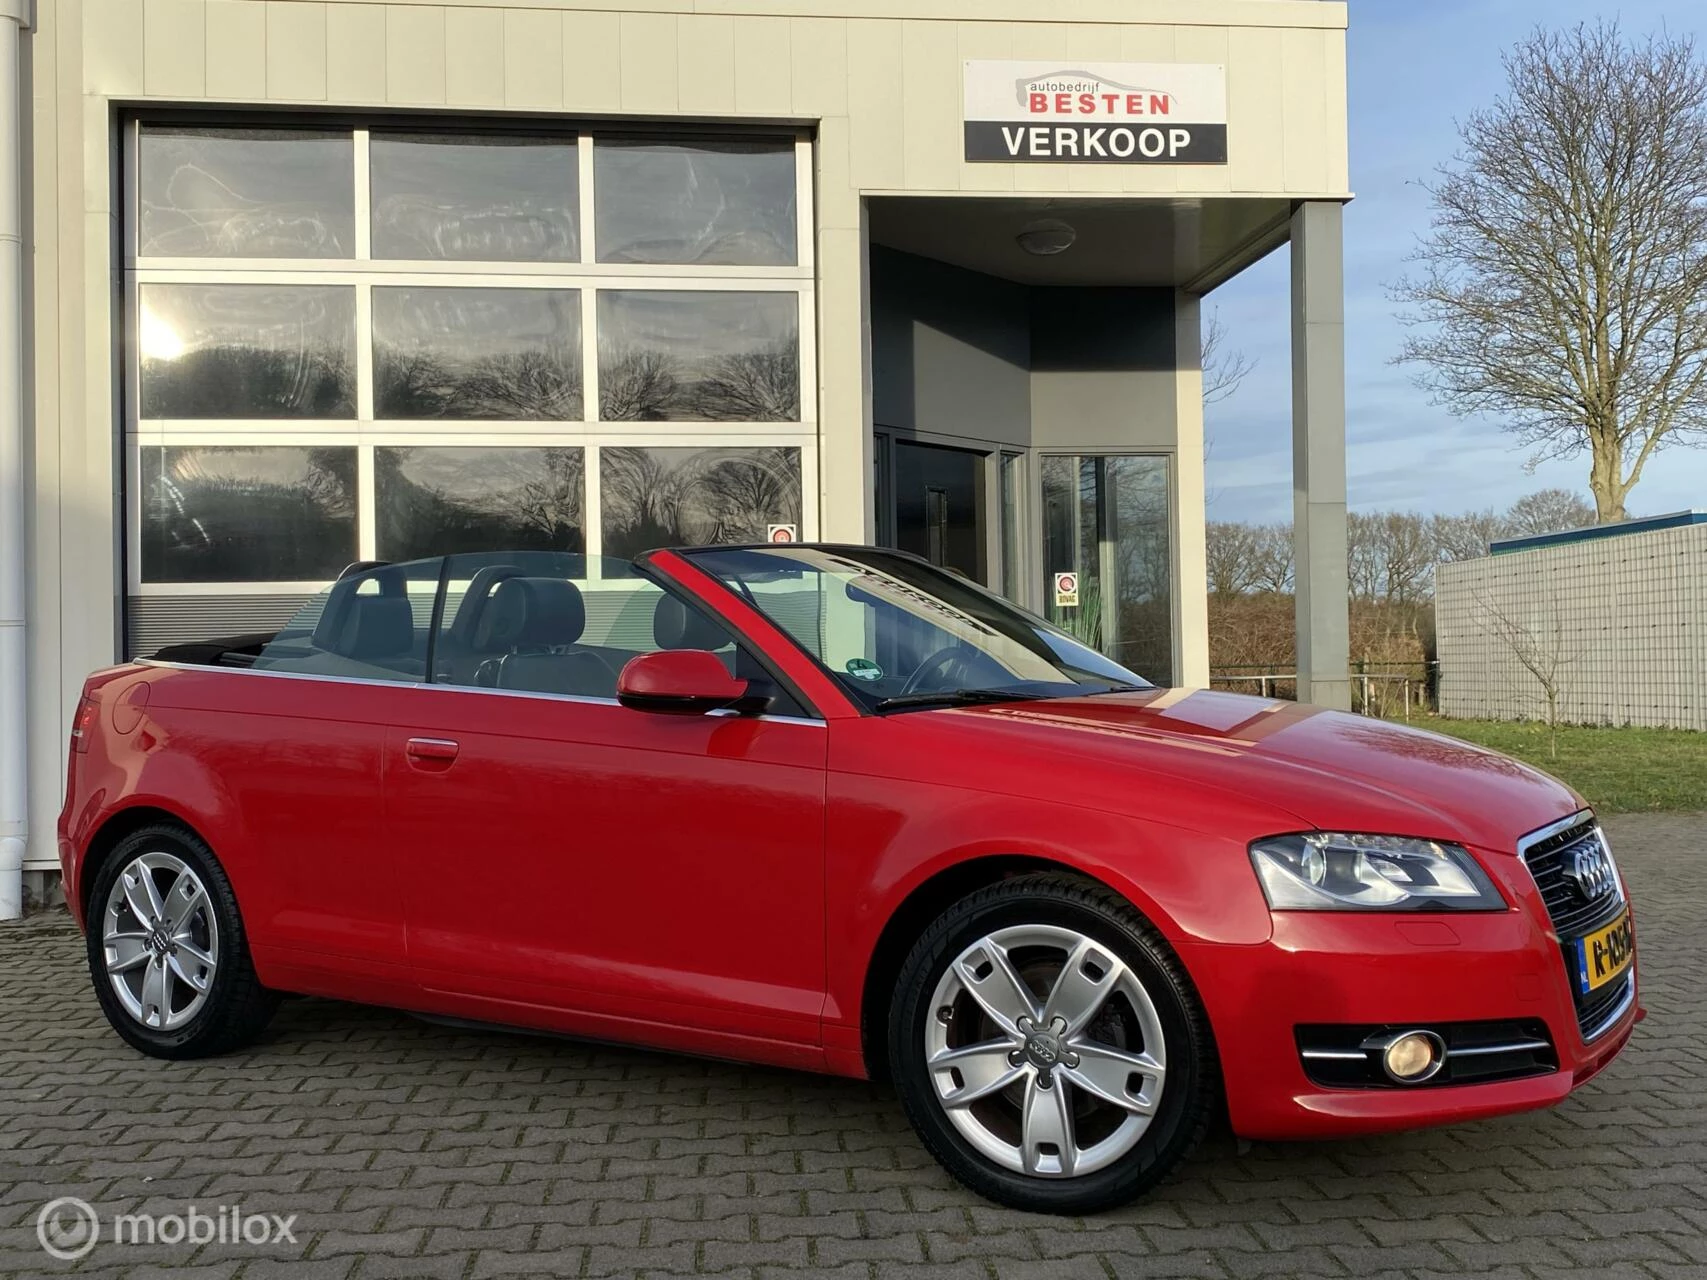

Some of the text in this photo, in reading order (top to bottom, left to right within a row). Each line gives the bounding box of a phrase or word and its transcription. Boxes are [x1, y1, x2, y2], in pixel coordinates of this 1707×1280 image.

[1030, 81, 1100, 94] autobedrijf
[1029, 93, 1169, 115] BESTEN
[1001, 127, 1191, 158] VERKOOP
